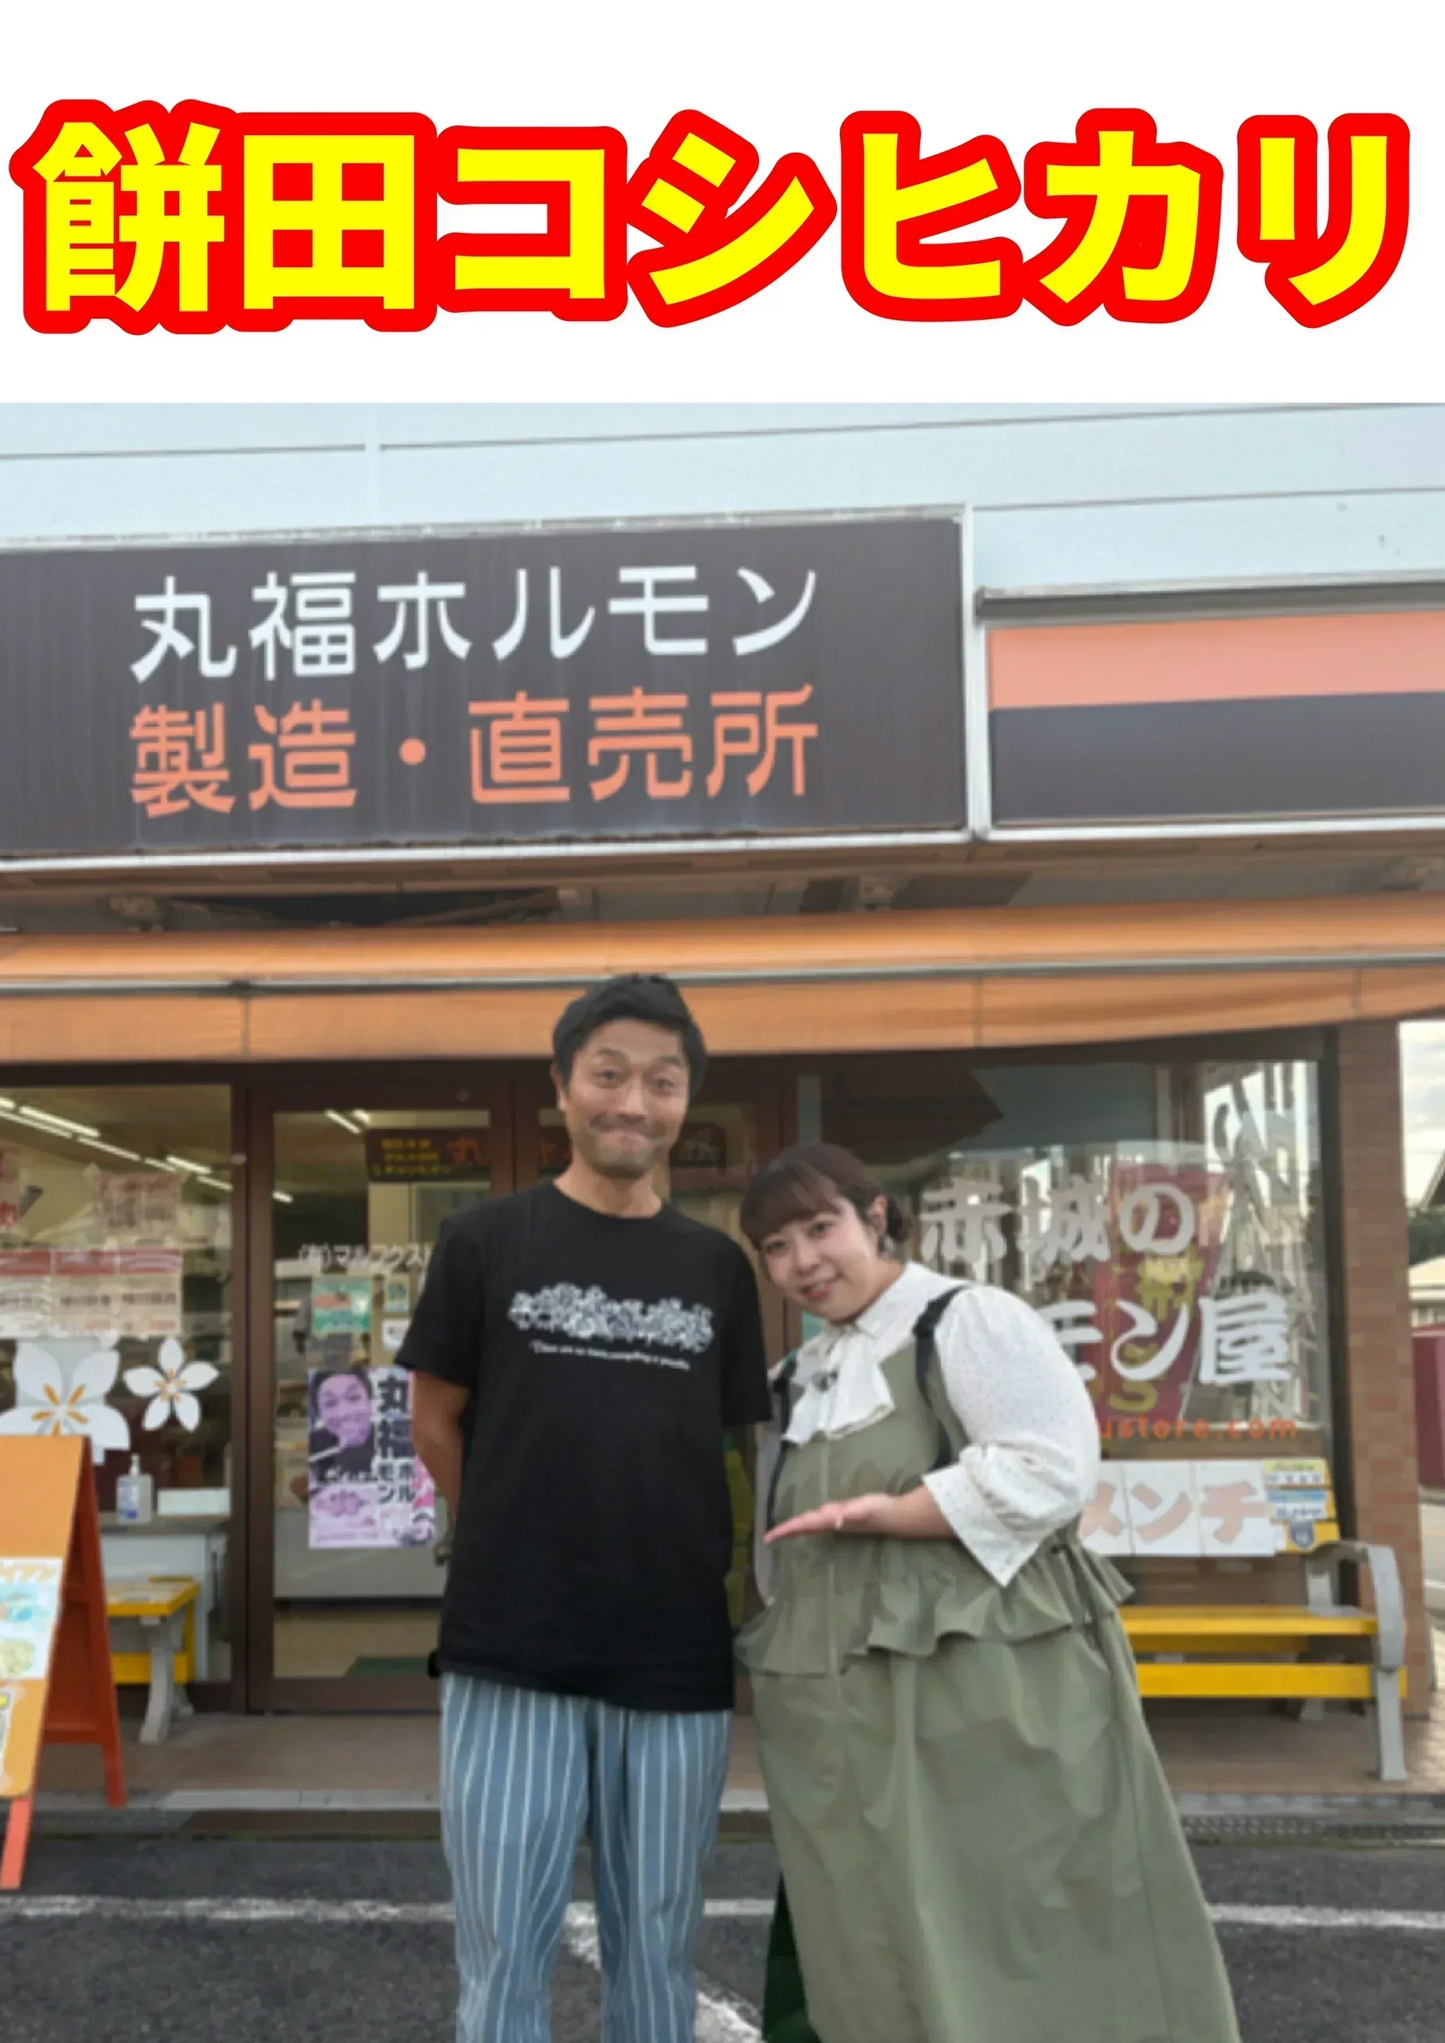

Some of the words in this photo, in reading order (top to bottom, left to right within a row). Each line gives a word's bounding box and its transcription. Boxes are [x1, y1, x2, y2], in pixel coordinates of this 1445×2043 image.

[129, 564, 818, 684] 丸福ホルモン
[129, 683, 818, 818] 製造・直売所
[920, 1175, 1196, 1263] 赤城の
[1079, 1480, 1267, 1544] メンチ
